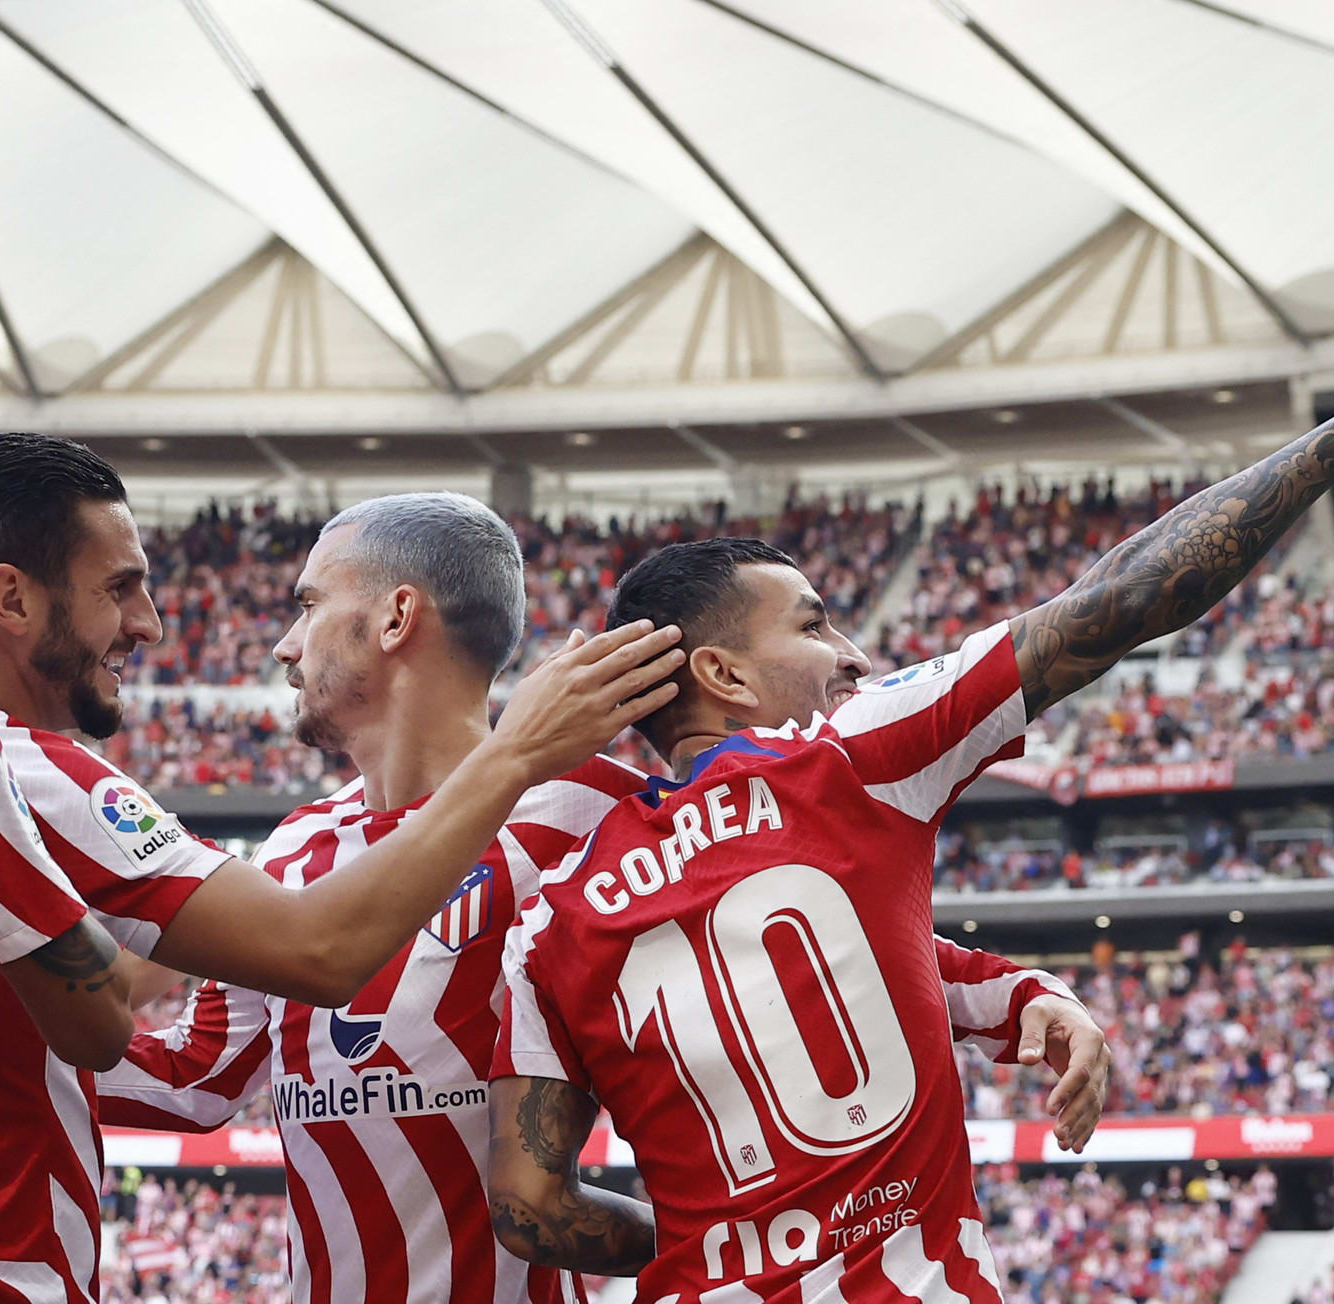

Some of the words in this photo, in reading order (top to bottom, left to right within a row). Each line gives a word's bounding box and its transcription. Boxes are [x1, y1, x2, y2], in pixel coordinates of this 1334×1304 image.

[133, 829, 181, 861] LaLiga
[583, 776, 783, 916] CORREA
[612, 863, 916, 1198] 10
[830, 1177, 917, 1222] Money
